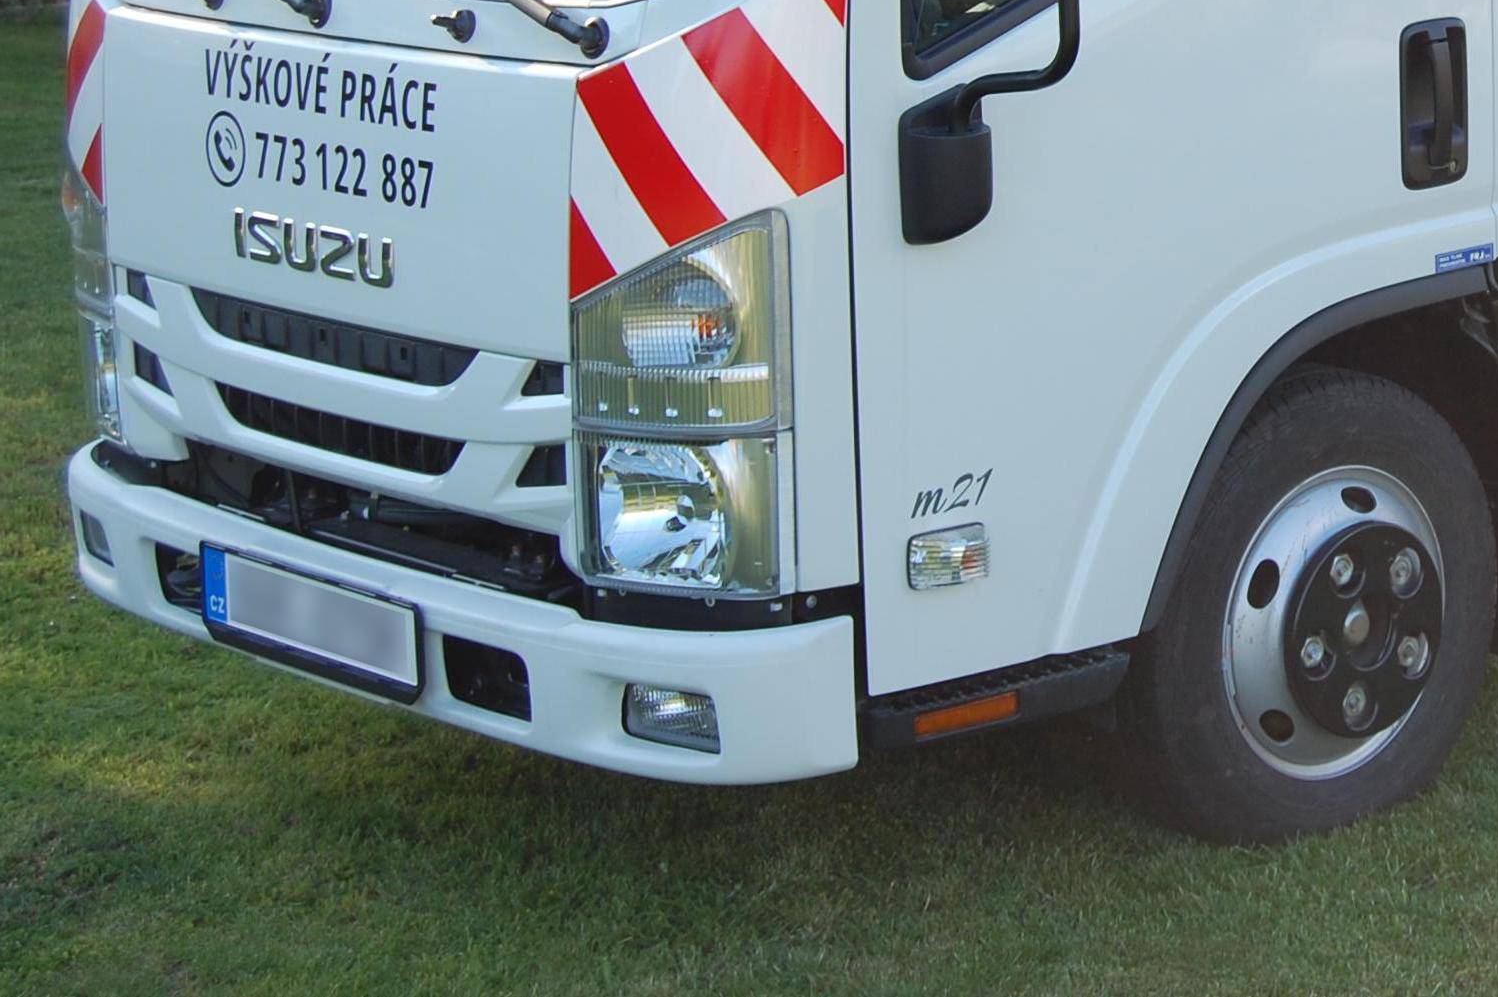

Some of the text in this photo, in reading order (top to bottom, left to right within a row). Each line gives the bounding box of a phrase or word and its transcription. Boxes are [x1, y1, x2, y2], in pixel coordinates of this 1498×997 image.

[204, 38, 438, 133] VÝŠKOVÉ PRÁCE
[255, 131, 434, 209] 773 122 887
[233, 207, 396, 289] ISUZU
[910, 467, 994, 519] m21
[209, 594, 226, 614] CZ
